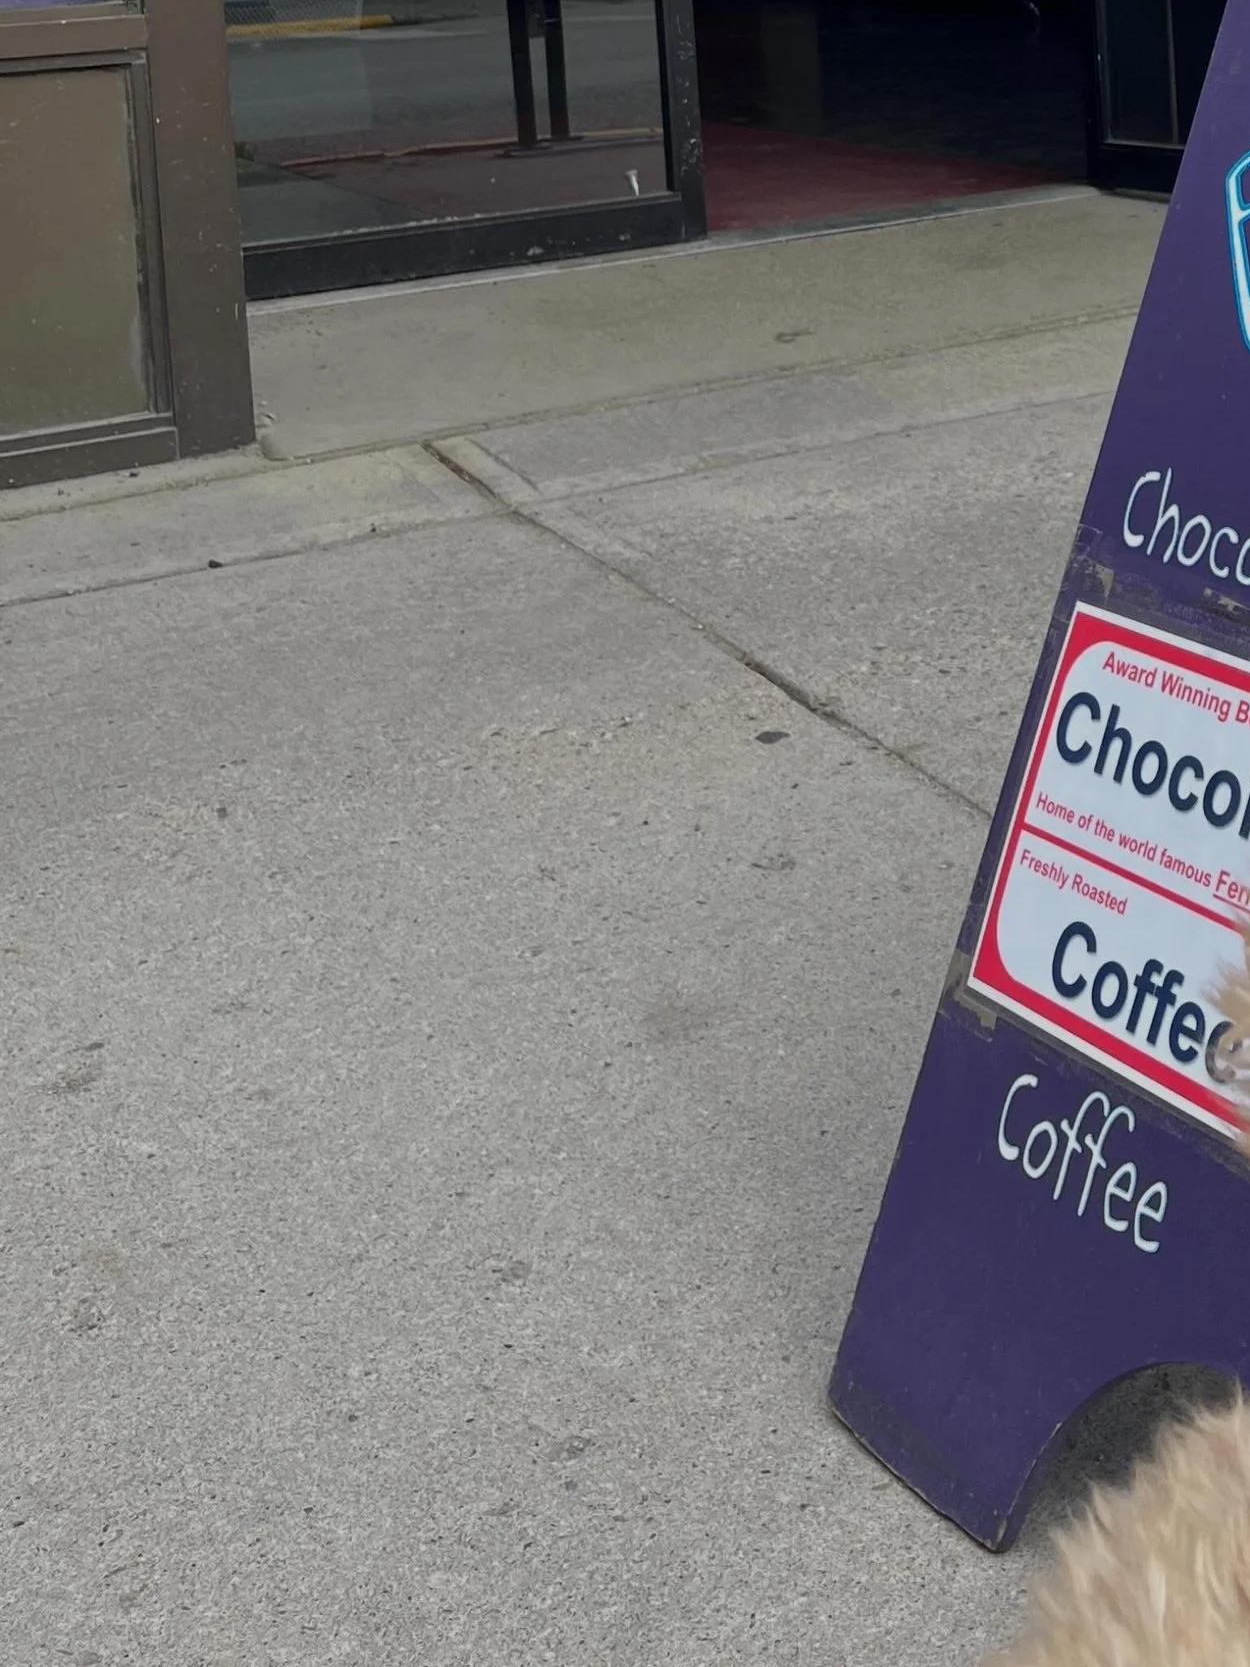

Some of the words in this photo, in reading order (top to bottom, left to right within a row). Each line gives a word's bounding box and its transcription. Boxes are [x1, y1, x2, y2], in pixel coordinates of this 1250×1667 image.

[1102, 651, 1157, 688] Award
[1160, 671, 1232, 723] Winning
[1020, 849, 1069, 890] Freshly
[1071, 873, 1129, 915] Roasted
[1036, 792, 1075, 824] Home
[1077, 814, 1093, 832] of
[1094, 820, 1116, 842] the
[1118, 831, 1159, 862] world
[1160, 848, 1213, 888] famous
[998, 1074, 1168, 1254] Coffee
